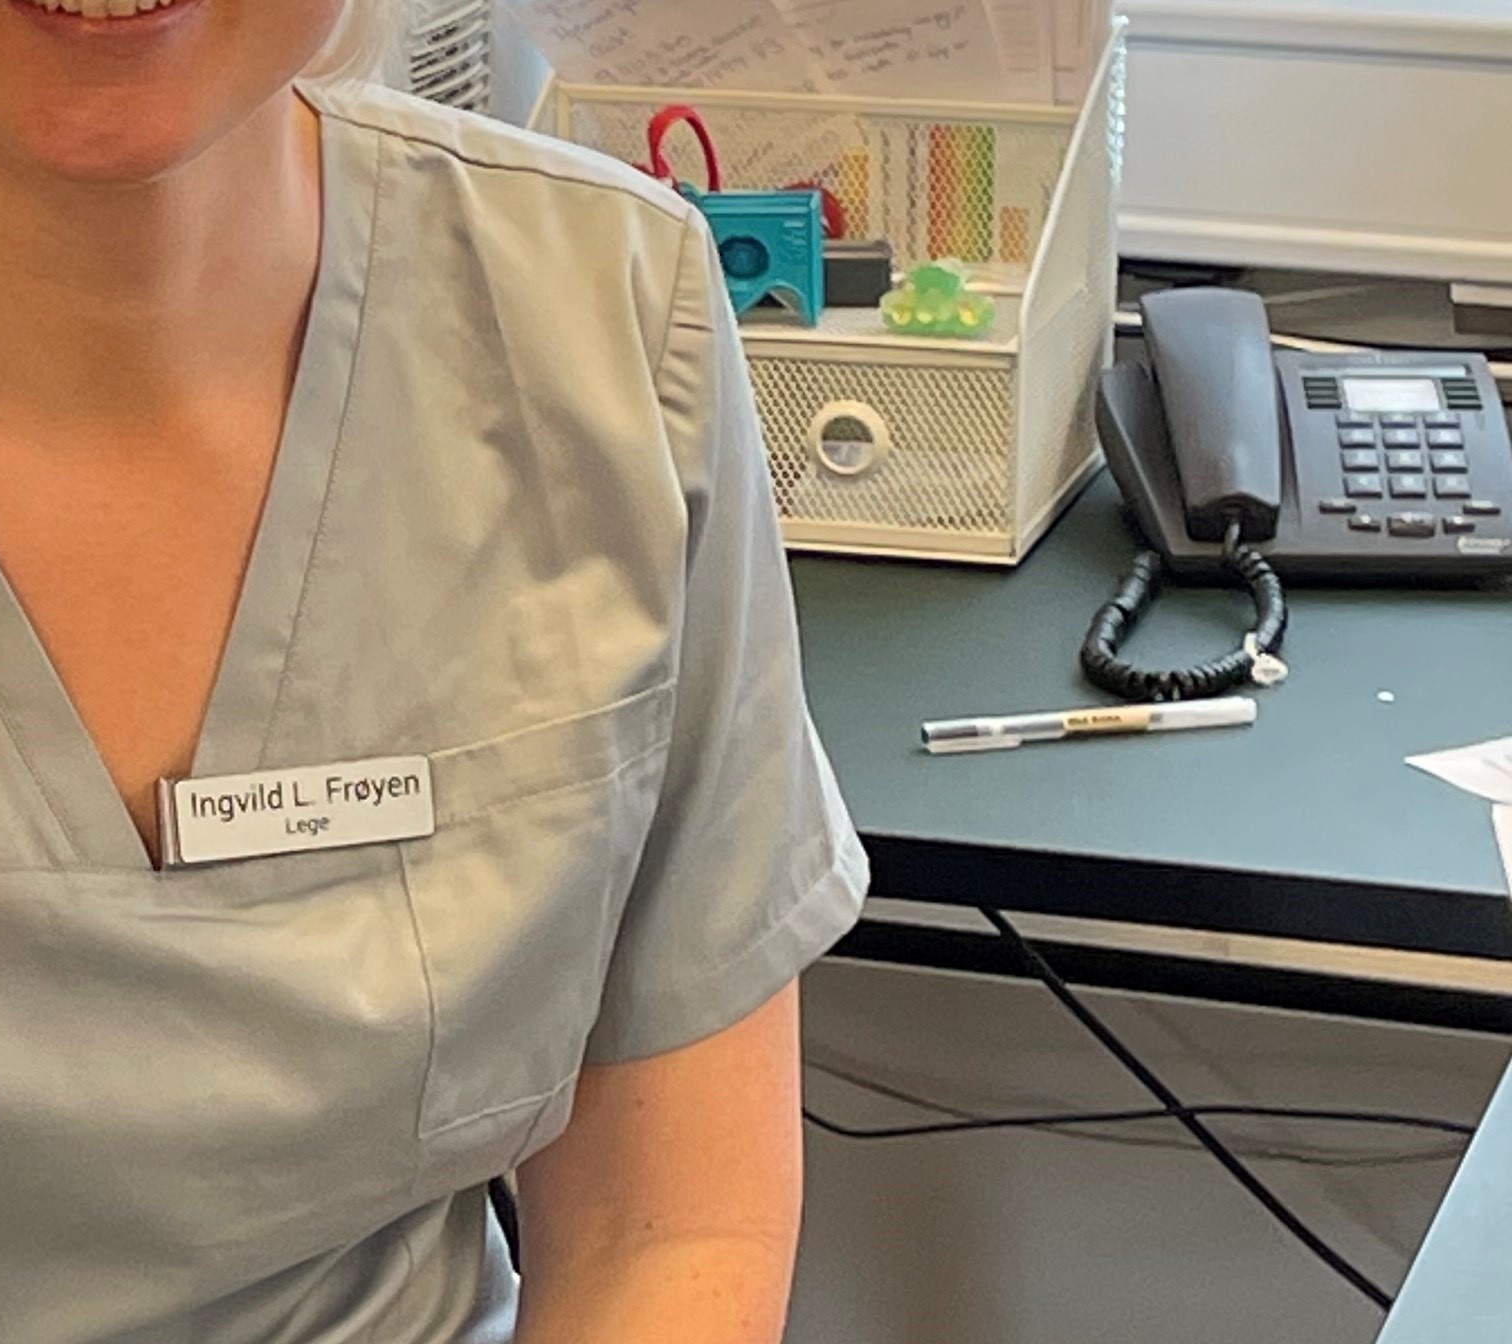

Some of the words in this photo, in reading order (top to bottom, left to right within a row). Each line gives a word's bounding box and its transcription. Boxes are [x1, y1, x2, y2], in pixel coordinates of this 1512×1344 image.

[191, 782, 283, 823] Ingvild
[326, 773, 421, 806] Frøyen
[285, 815, 331, 835] Lege
